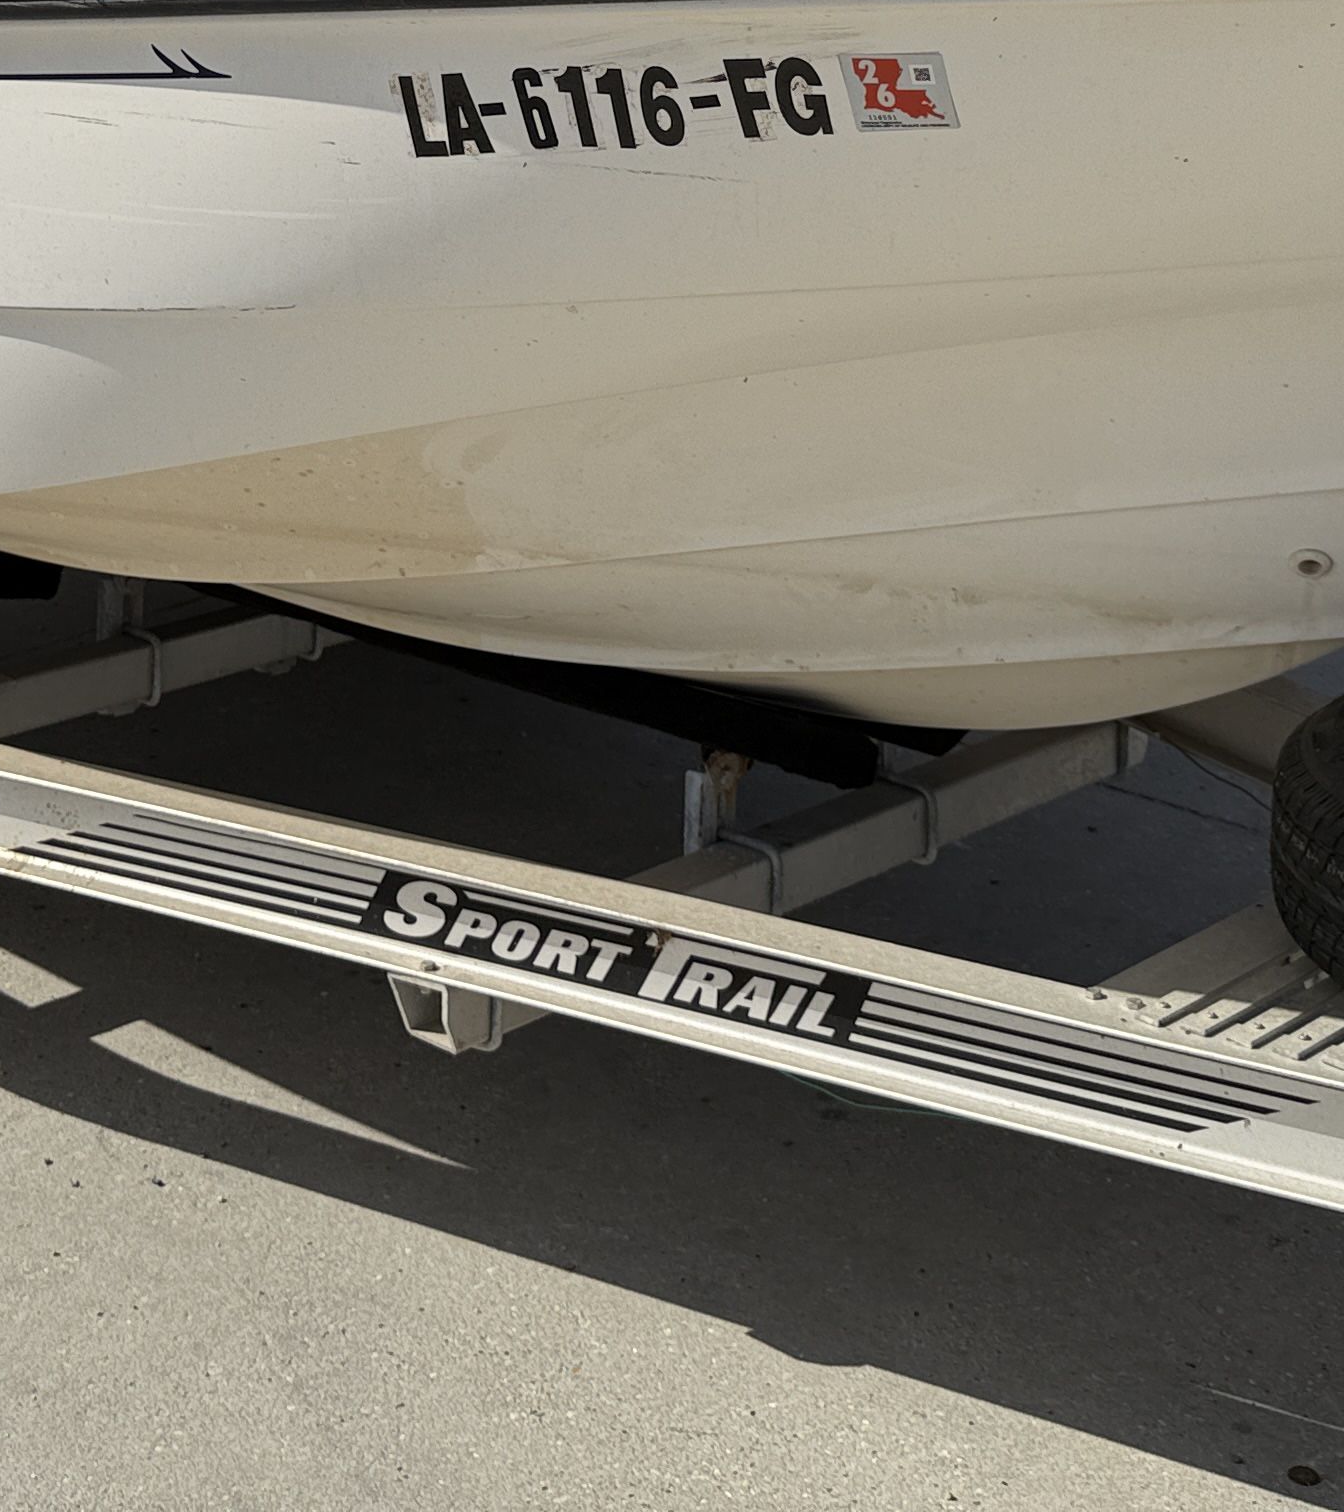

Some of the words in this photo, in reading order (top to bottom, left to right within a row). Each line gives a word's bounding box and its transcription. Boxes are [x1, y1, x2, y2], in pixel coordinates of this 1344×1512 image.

[398, 56, 834, 158] LA-6116-FG
[382, 880, 634, 983] SPORT
[637, 930, 838, 1039] TRAIL
